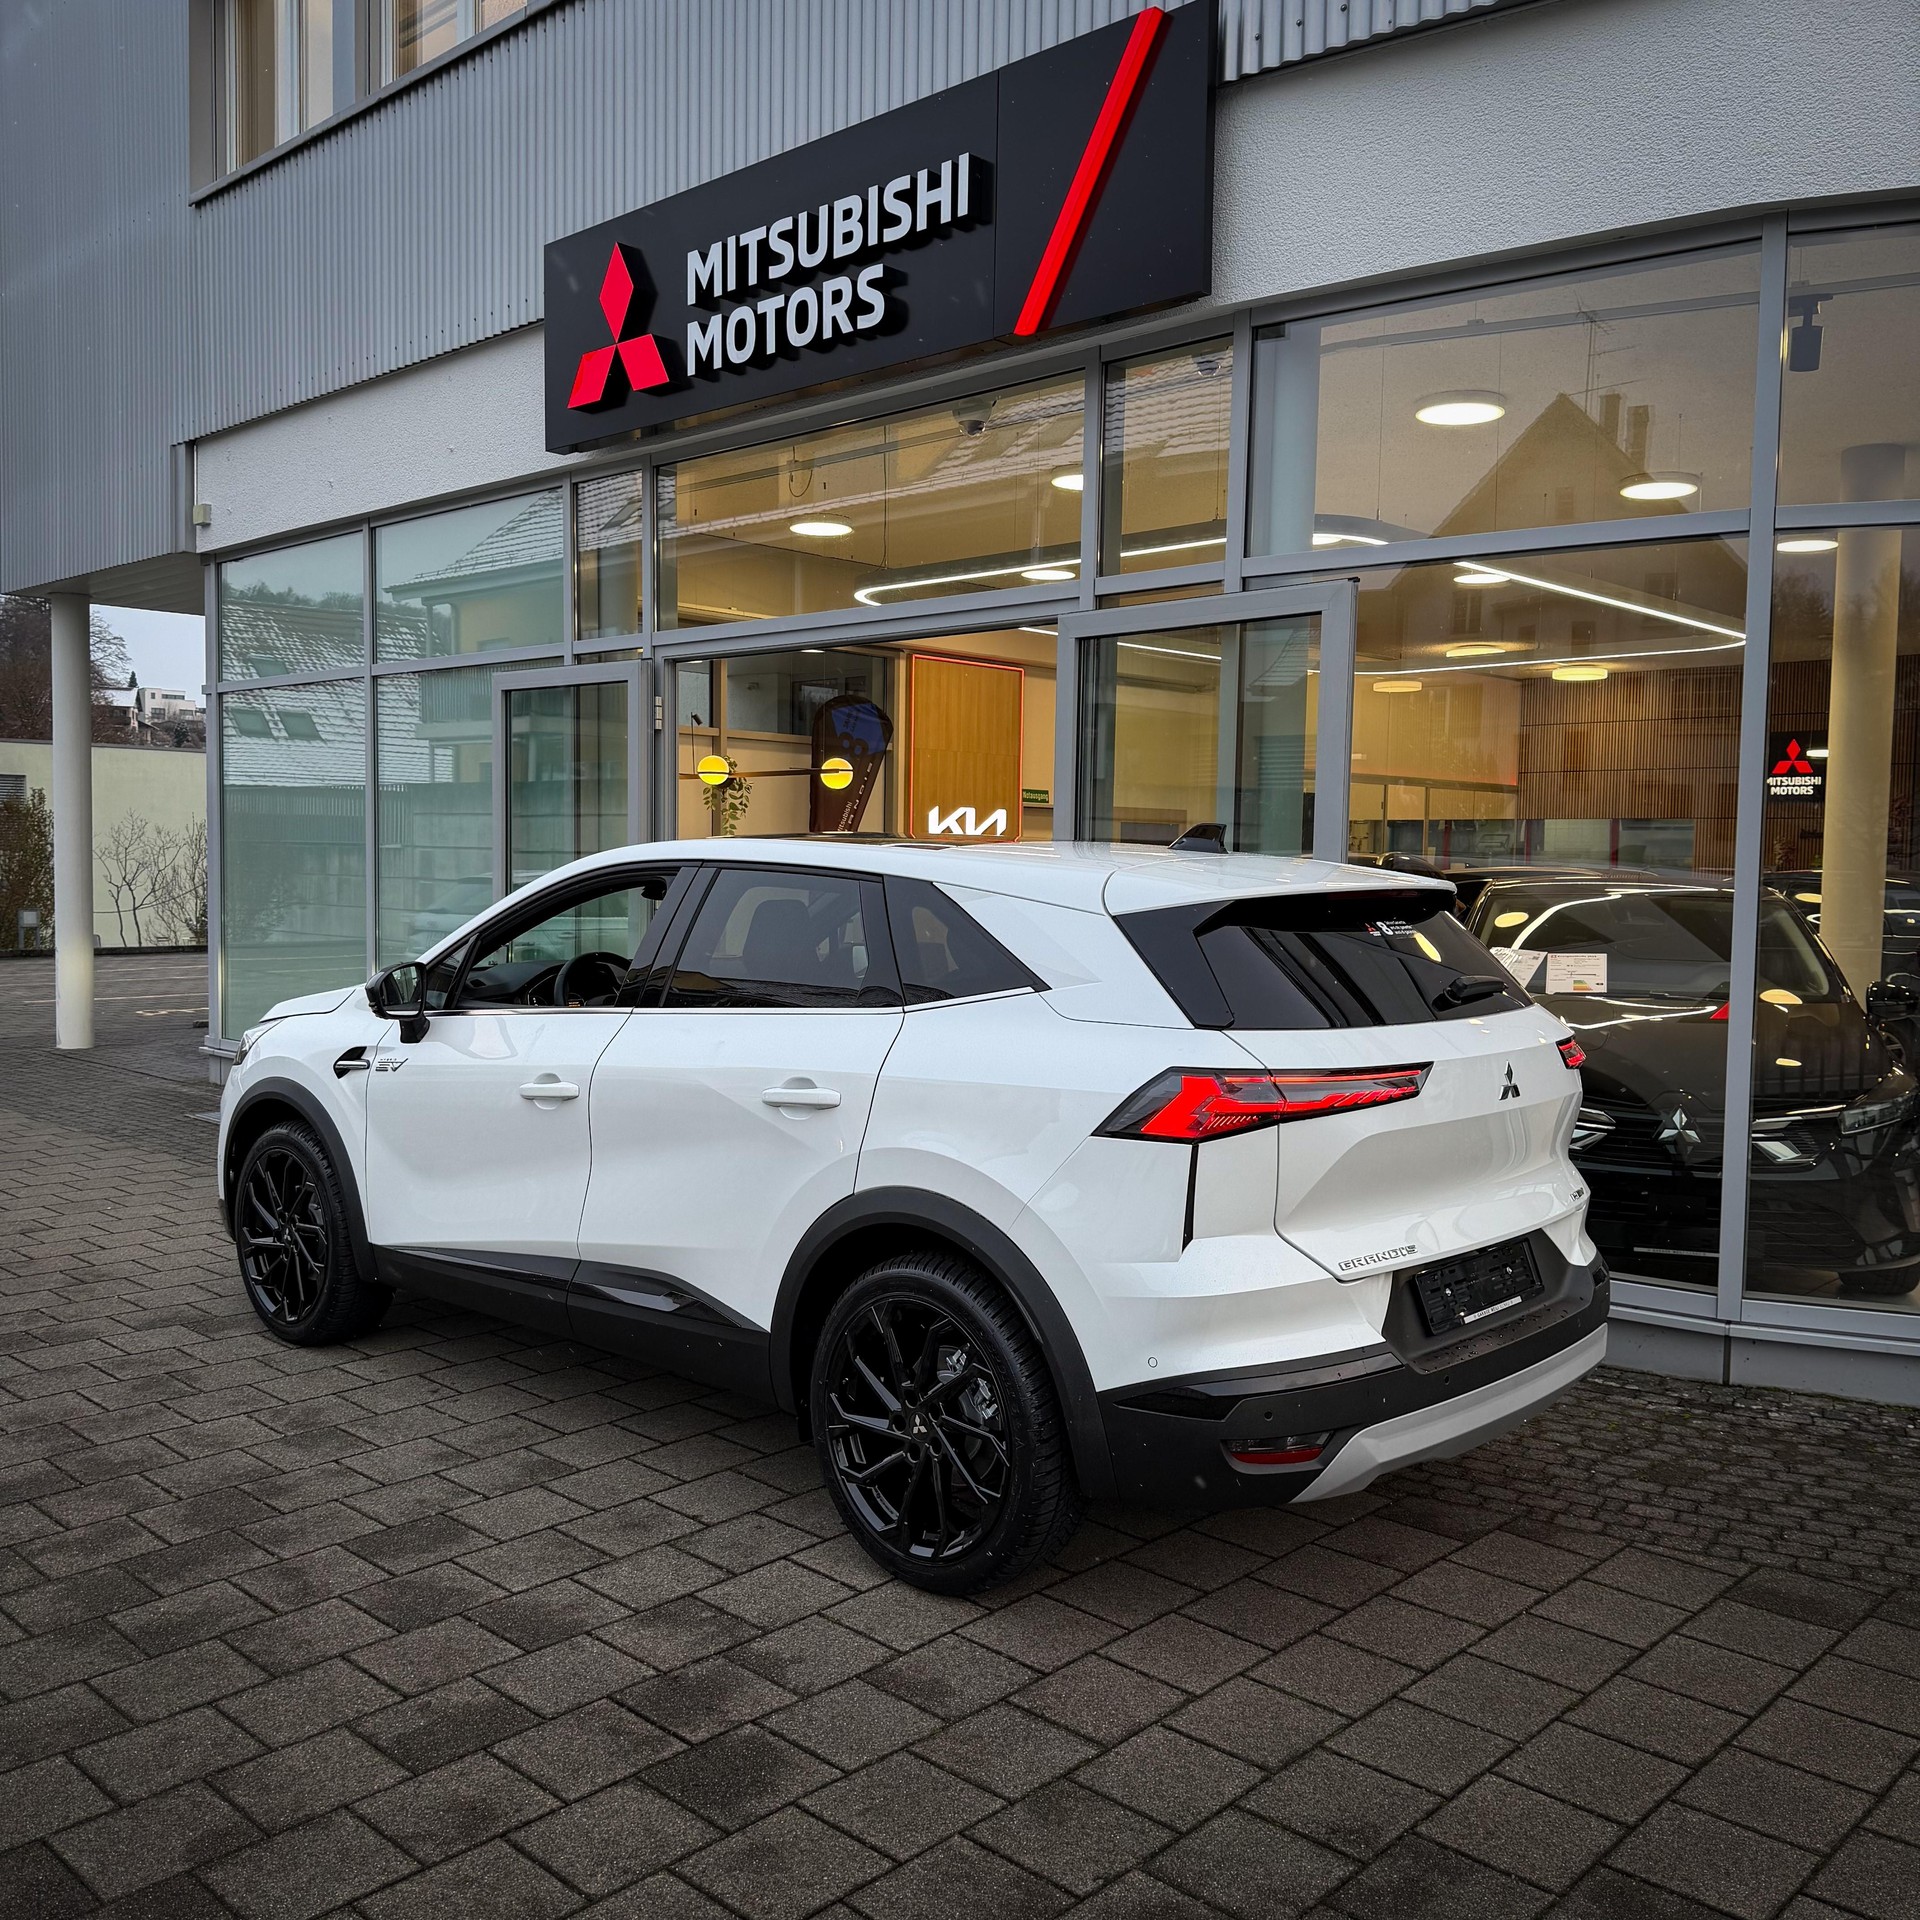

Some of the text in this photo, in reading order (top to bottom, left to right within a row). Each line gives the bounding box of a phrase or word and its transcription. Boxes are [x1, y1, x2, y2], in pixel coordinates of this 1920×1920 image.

[687, 152, 970, 305] MITSUBISHI
[687, 263, 885, 376] MOTORS
[1770, 786, 1814, 795] MOTORS
[928, 805, 1007, 836] KIA
[1376, 921, 1394, 935] 8
[1338, 1244, 1418, 1271] GRANDIS
